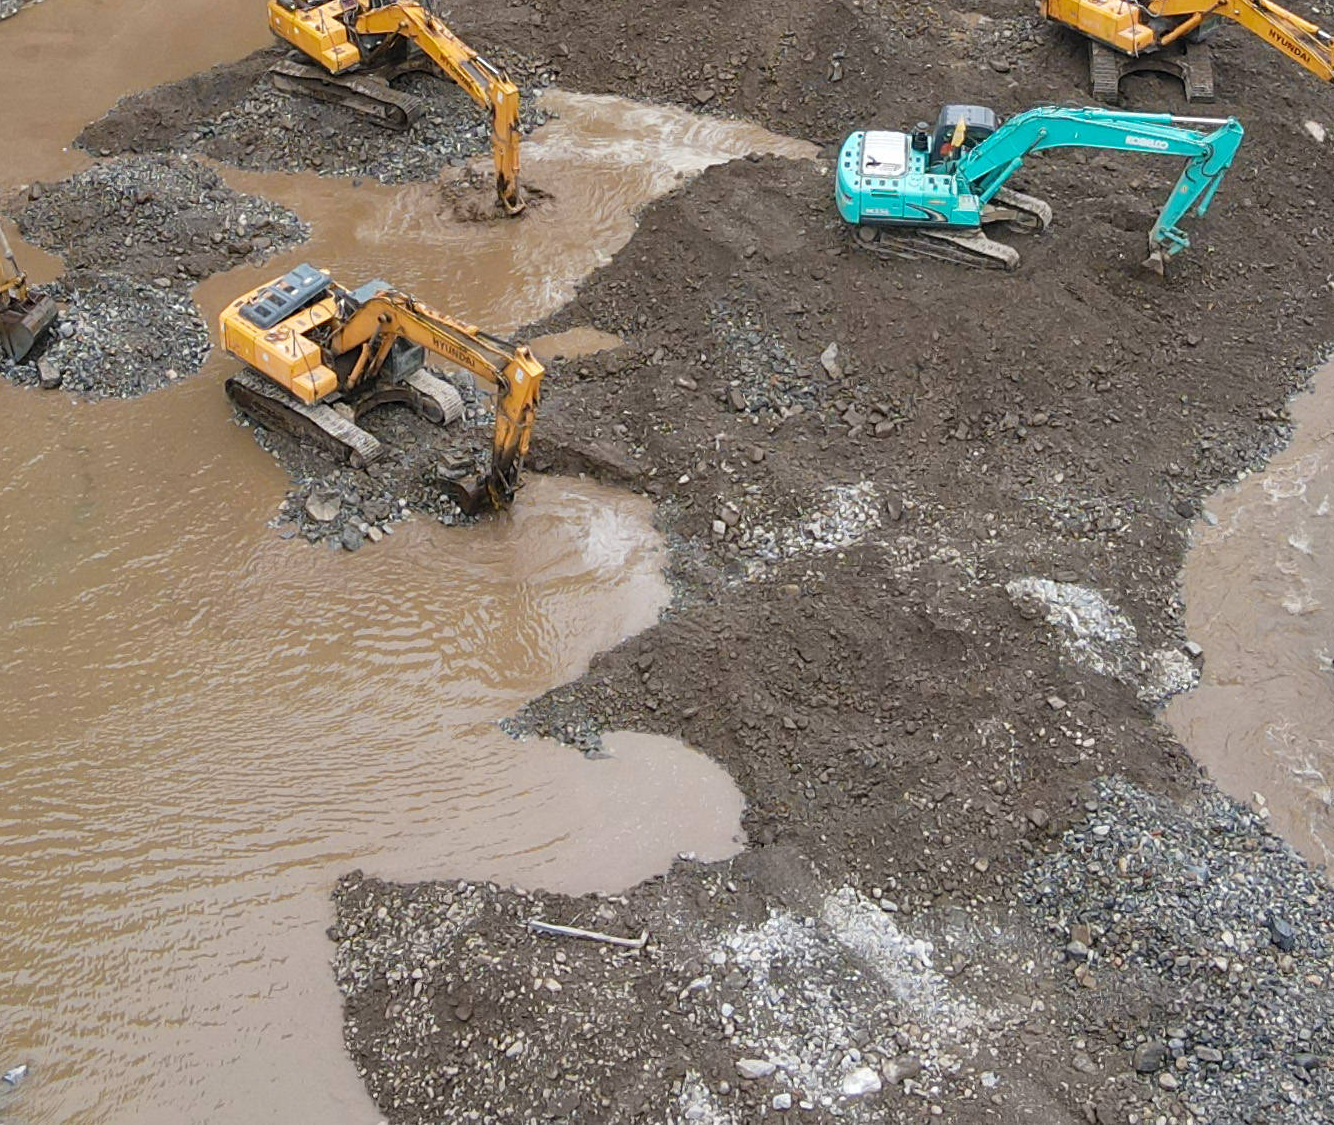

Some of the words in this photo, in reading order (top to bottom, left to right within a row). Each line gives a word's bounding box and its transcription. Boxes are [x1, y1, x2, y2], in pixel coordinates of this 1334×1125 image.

[1268, 28, 1310, 62] HYUNDAI
[1125, 135, 1169, 149] KOBELCO
[432, 333, 475, 367] HYUNDAI
